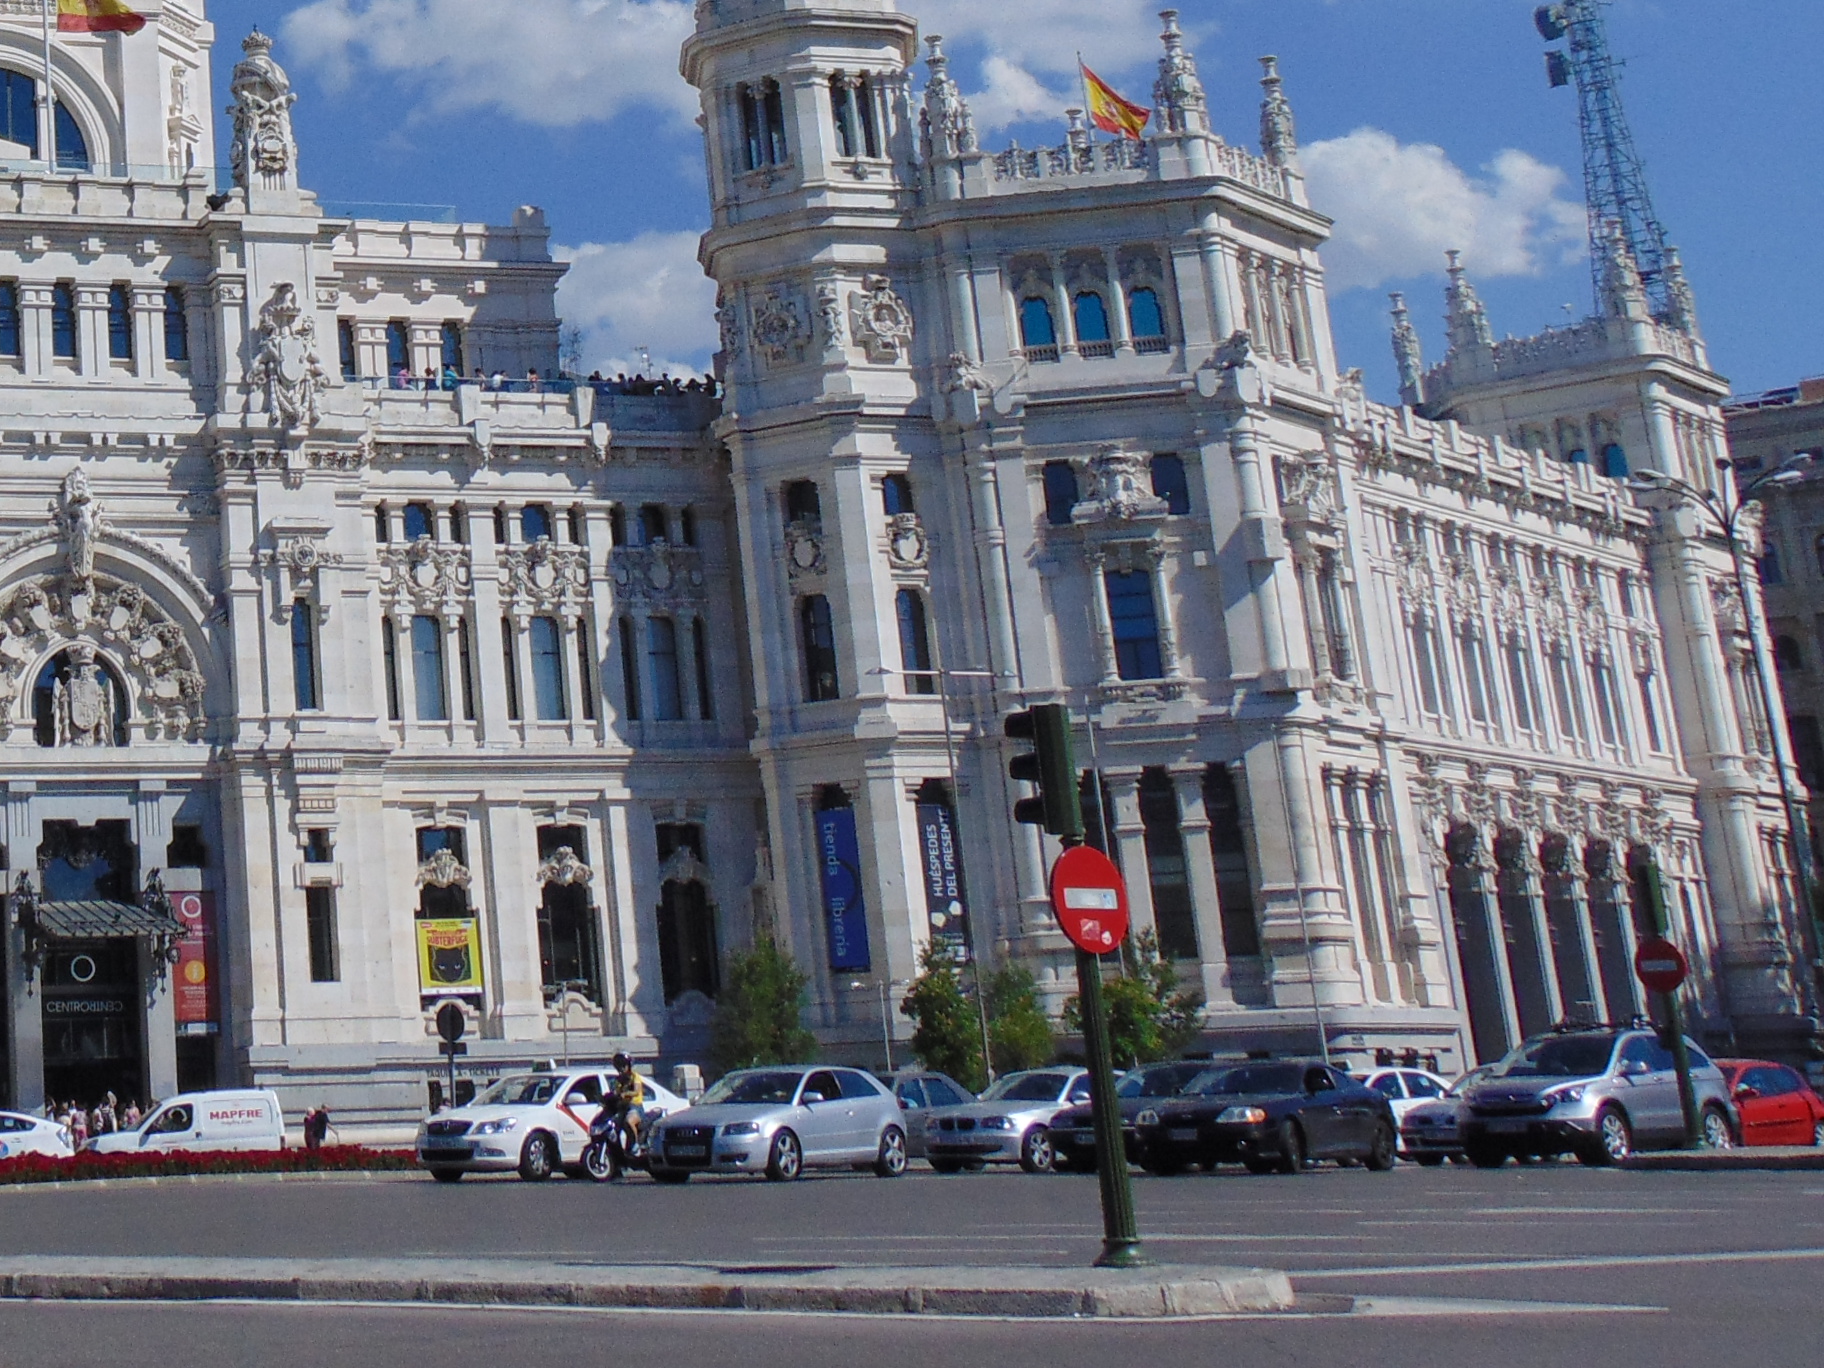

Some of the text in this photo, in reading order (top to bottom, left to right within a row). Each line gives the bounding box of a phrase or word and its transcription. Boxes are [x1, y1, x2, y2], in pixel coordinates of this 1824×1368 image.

[824, 823, 840, 876] tienda
[926, 824, 943, 897] HUÉSPEDES
[946, 872, 958, 897] DEL
[209, 1109, 263, 1120] MAPFRE
